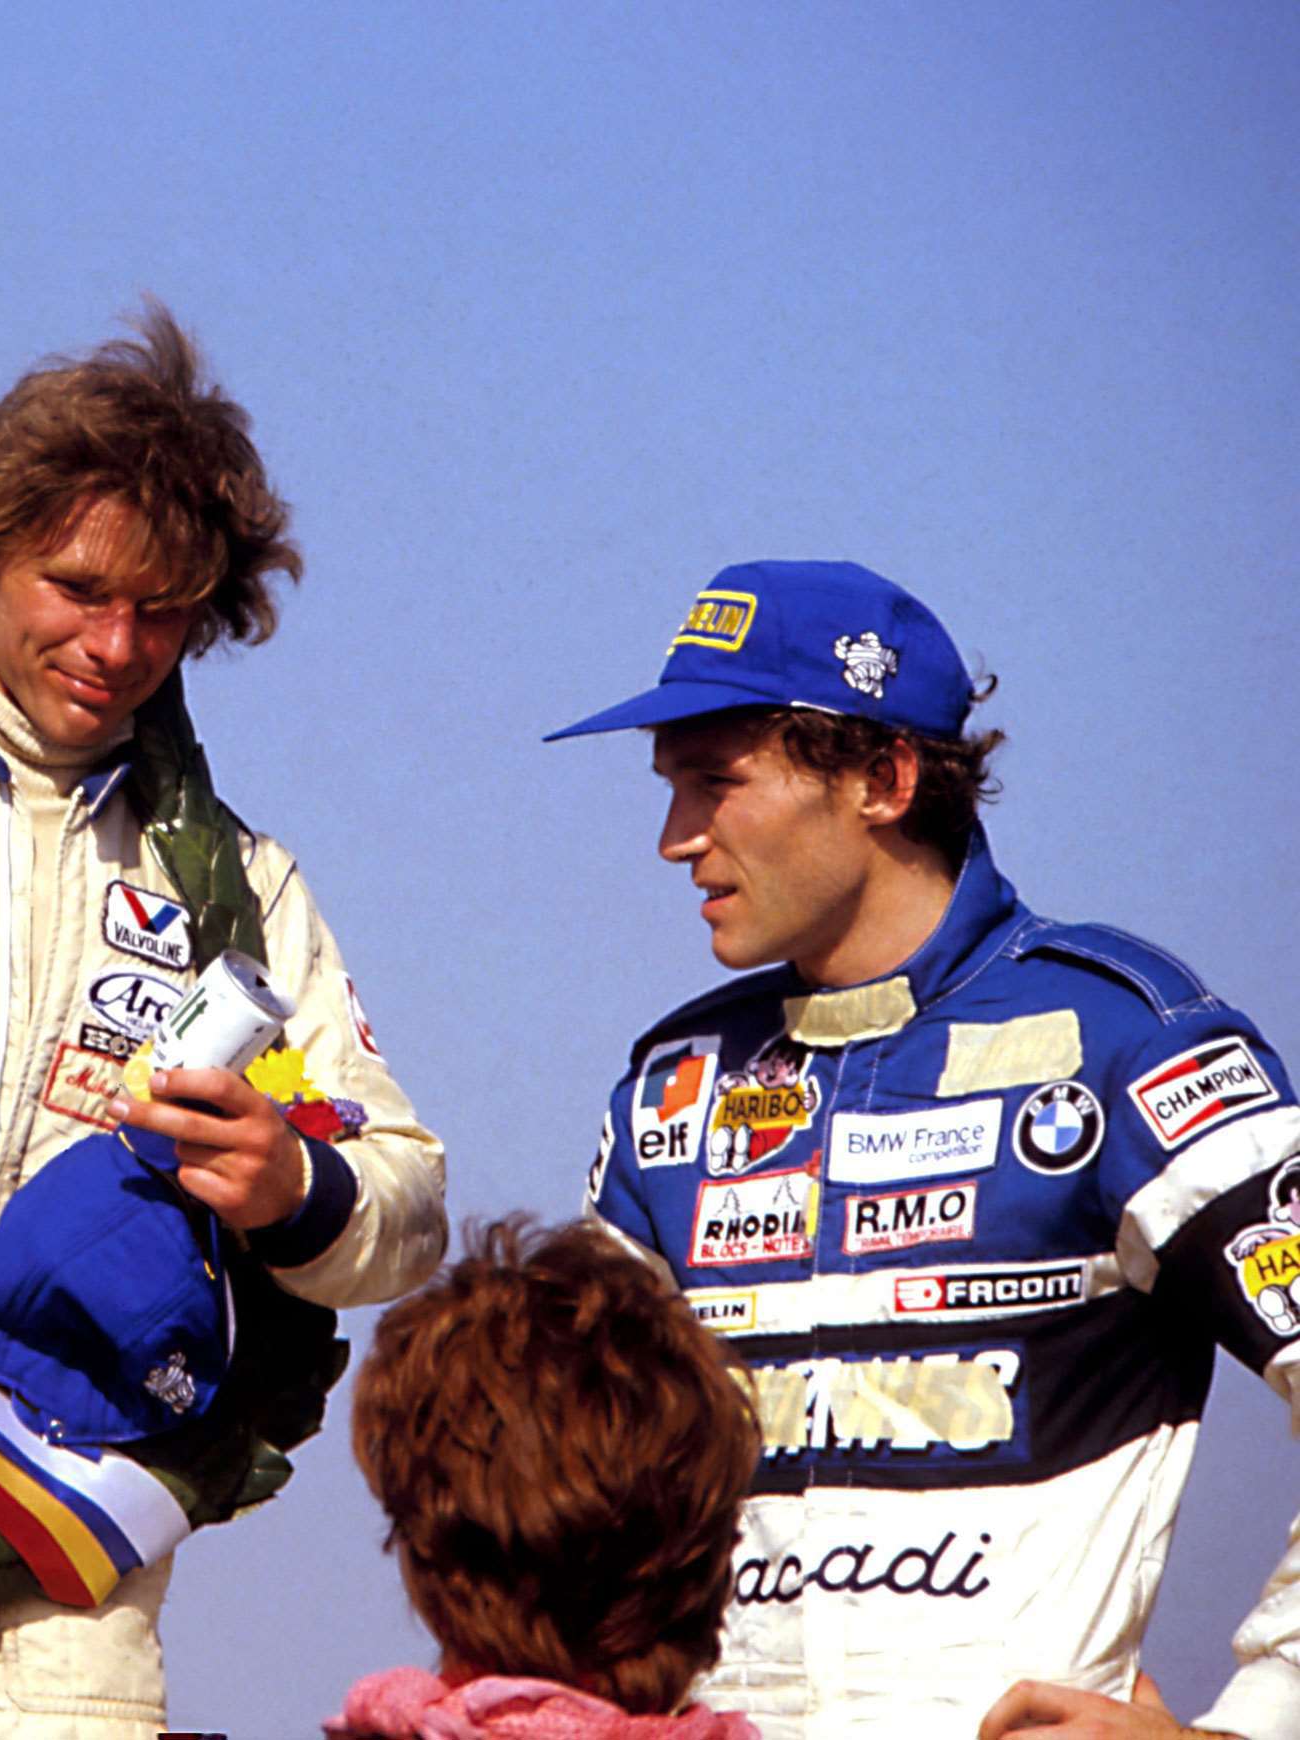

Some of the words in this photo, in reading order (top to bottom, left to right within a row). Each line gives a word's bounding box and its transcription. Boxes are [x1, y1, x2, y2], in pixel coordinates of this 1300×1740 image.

[114, 920, 184, 965] VALVOLINE
[723, 1091, 802, 1121] HARIBO
[1027, 1085, 1095, 1117] BMW
[1155, 1062, 1256, 1120] CHAMPION
[638, 1121, 688, 1160] elf
[847, 1129, 908, 1154] BMW
[855, 1190, 966, 1235] R.M.O
[946, 1273, 1081, 1305] FACOM
[698, 1304, 745, 1319] ELIN
[736, 1531, 990, 1606] acadi
